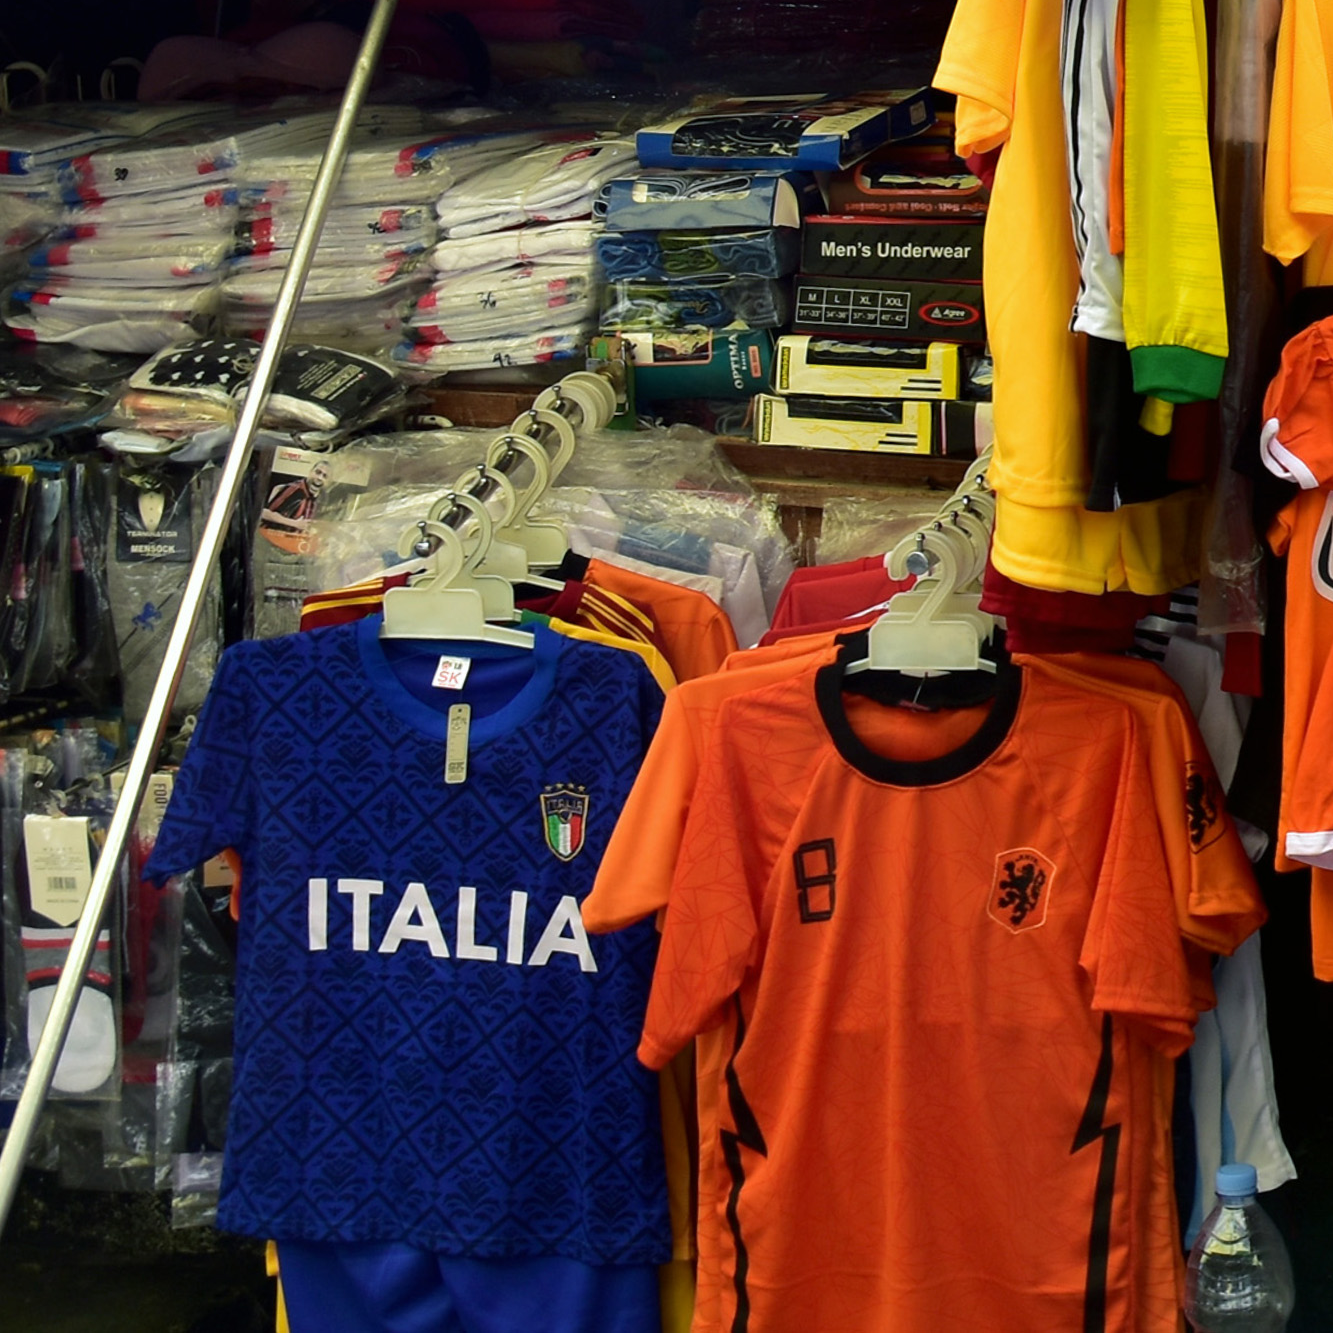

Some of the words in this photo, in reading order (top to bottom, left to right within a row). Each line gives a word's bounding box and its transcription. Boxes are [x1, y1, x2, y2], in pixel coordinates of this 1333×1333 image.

[821, 241, 872, 258] Men's
[876, 242, 972, 259] Underwear
[808, 293, 817, 301] M
[834, 294, 840, 303] L
[859, 295, 872, 305] XL
[885, 297, 904, 307] XXL
[728, 333, 744, 389] OPTIMA
[437, 671, 461, 684] SK
[794, 837, 837, 924] 8
[307, 876, 598, 973] ITALIA
